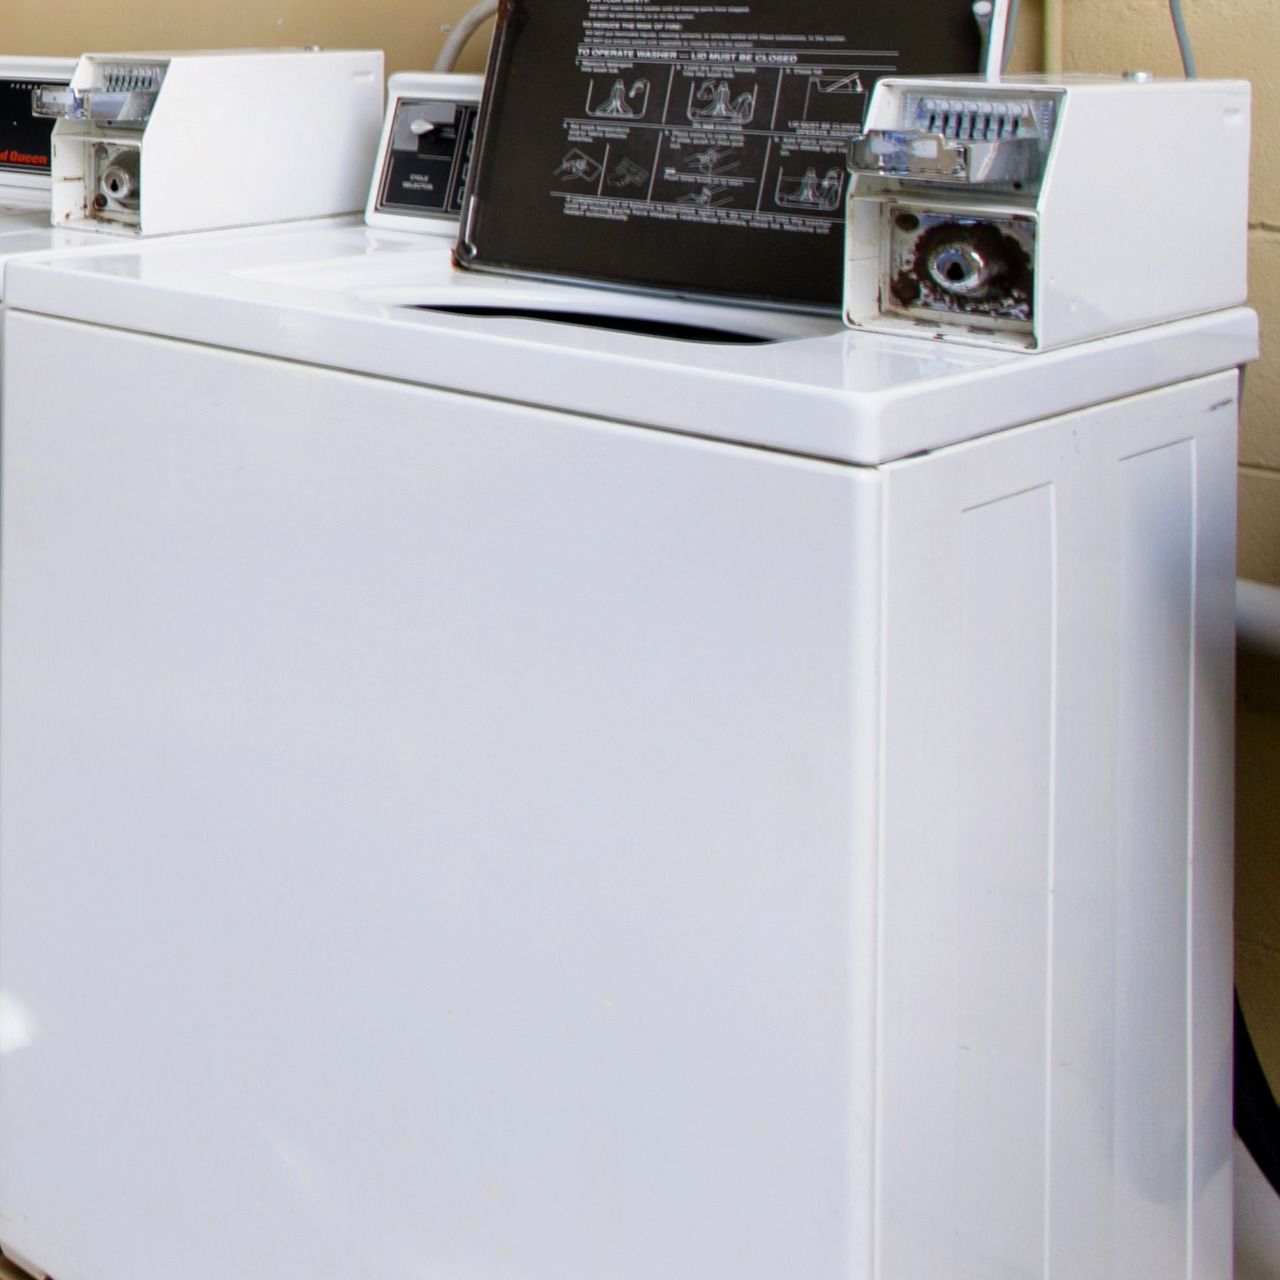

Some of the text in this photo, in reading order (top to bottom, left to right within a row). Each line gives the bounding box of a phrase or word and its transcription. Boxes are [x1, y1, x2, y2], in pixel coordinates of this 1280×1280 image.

[637, 51, 677, 59] WASHER
[709, 53, 736, 62] MUST
[739, 54, 752, 62] BE
[756, 55, 797, 63] CLOSED
[9, 150, 48, 164] Queen
